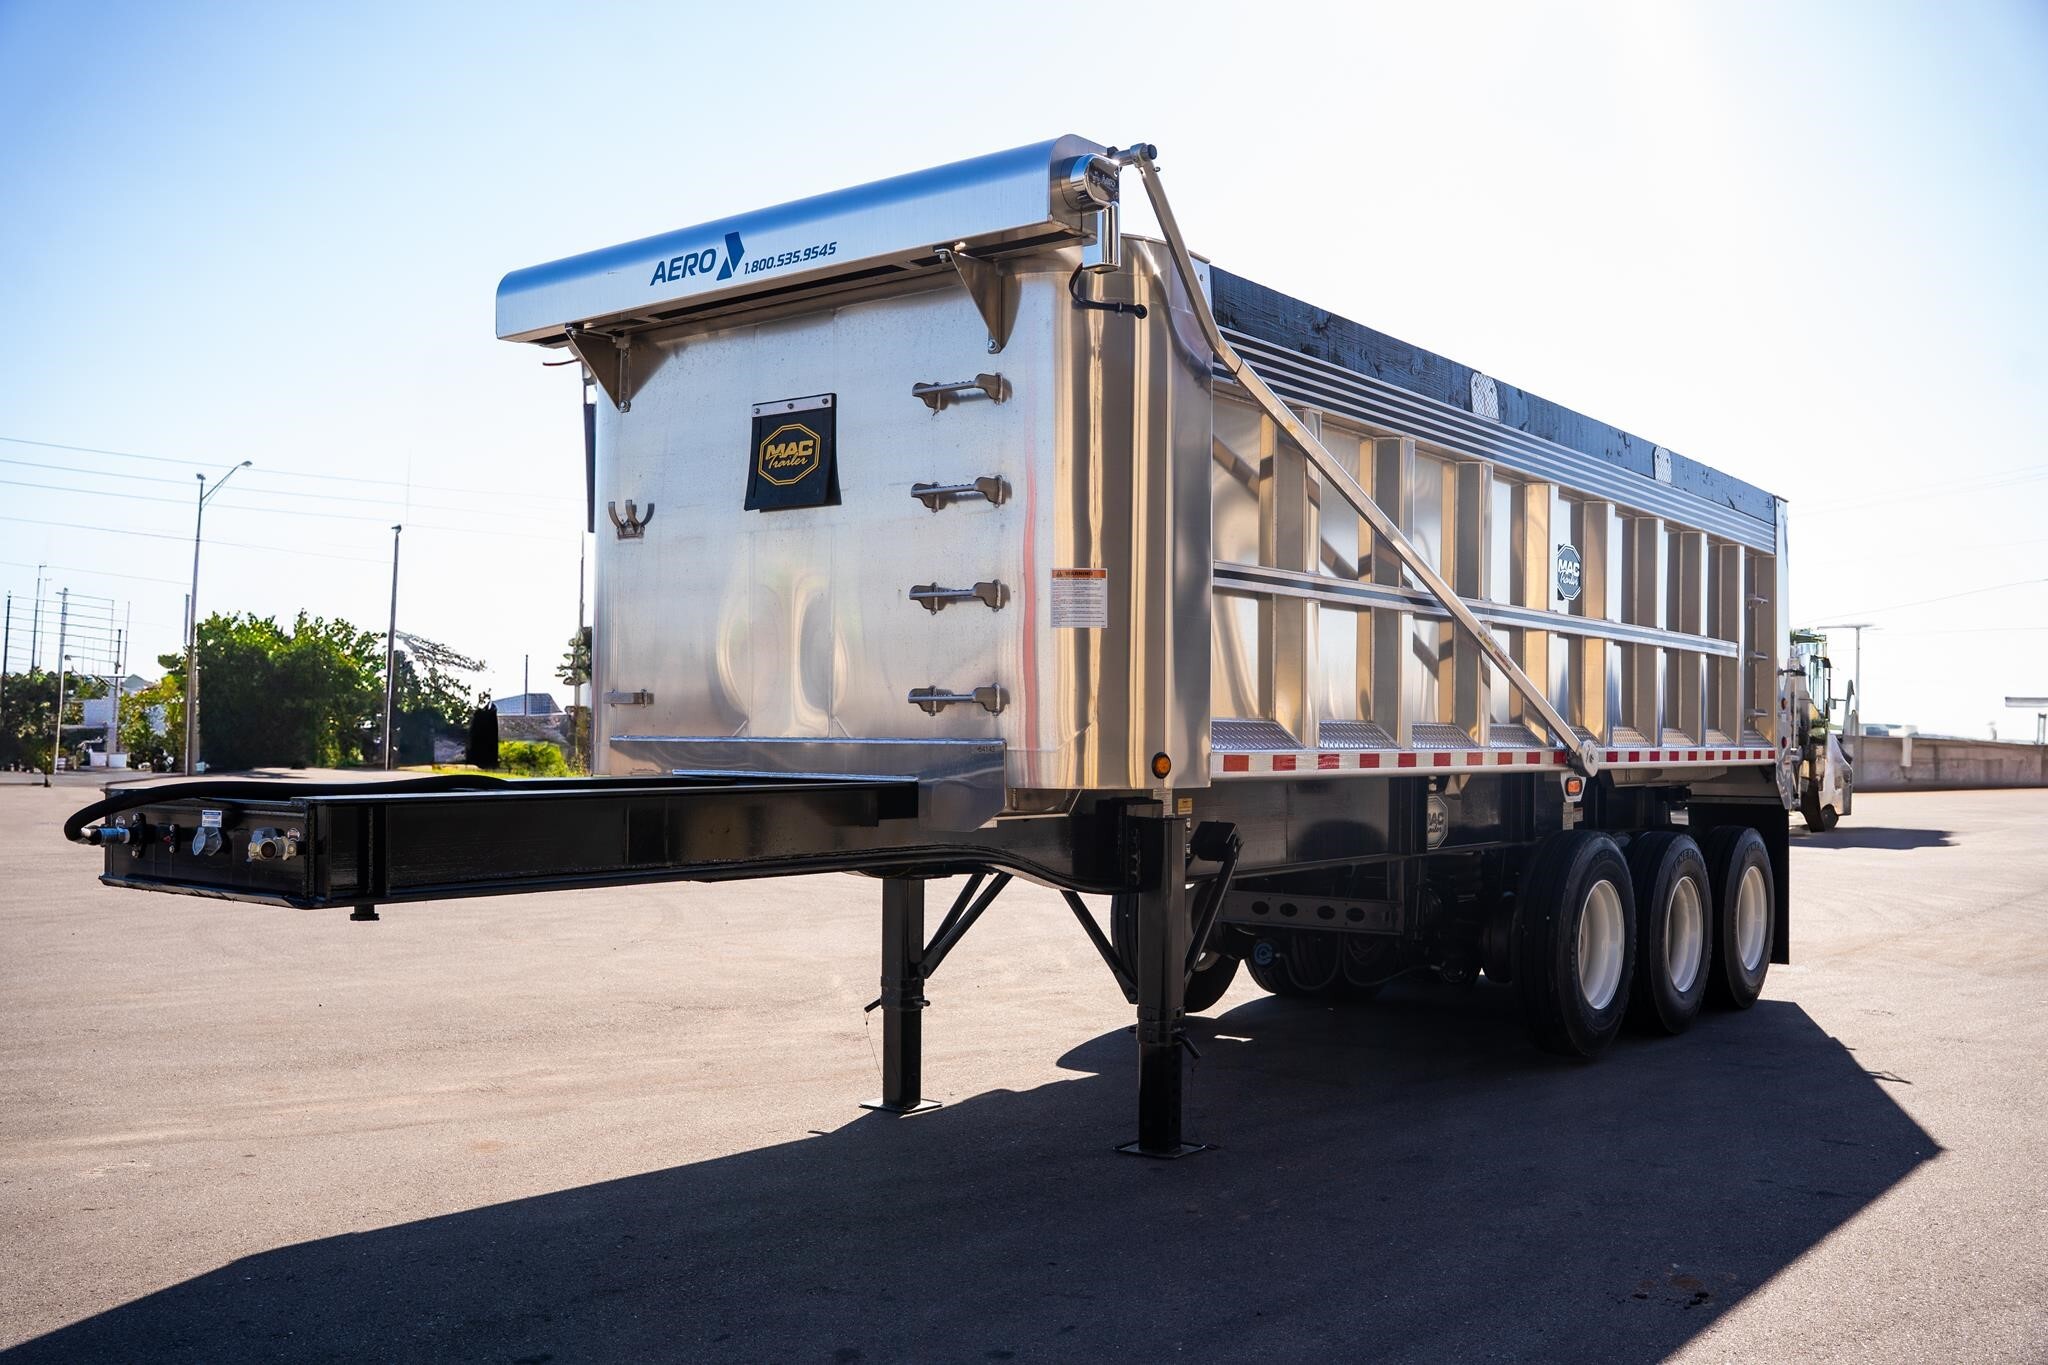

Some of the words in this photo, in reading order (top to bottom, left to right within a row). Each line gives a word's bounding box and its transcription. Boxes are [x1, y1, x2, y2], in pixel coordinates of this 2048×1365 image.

[650, 248, 717, 286] AERO
[744, 241, 837, 275] 1.800.535.9545
[765, 439, 814, 461] MAC
[768, 453, 808, 469] Trailer
[1558, 559, 1580, 577] MAC
[1428, 812, 1445, 826] AC
